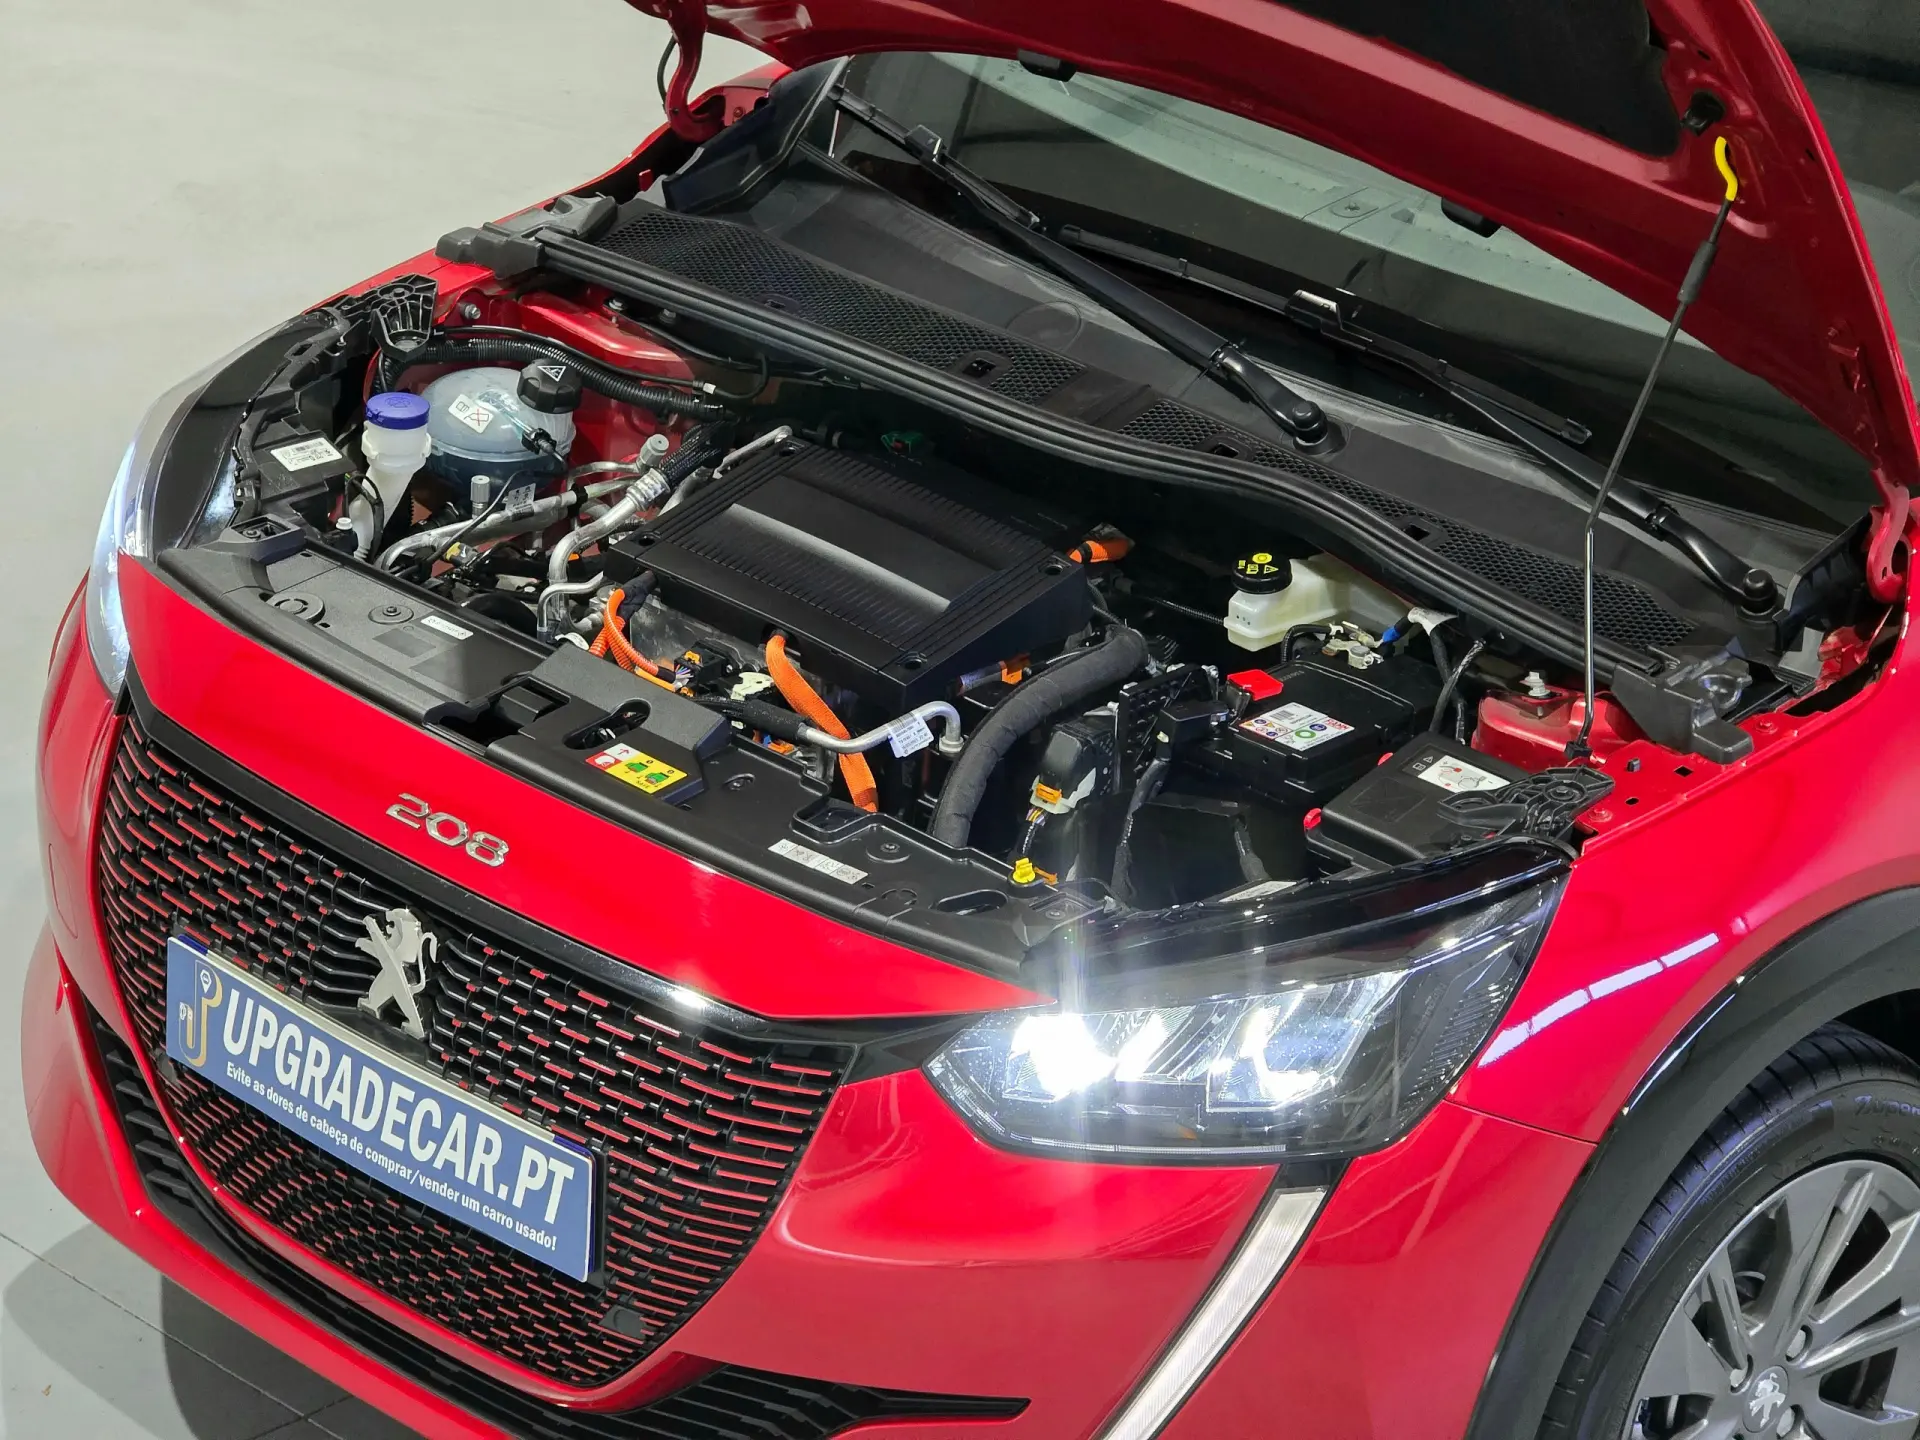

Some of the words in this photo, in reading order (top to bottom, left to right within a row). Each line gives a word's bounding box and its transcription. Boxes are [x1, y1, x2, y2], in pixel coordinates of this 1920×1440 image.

[385, 792, 510, 867] 208
[222, 988, 575, 1225] UPGRADECAR.PT
[226, 1061, 252, 1088] Evite
[252, 1078, 265, 1095] as
[266, 1086, 295, 1115] dores
[297, 1106, 309, 1124] de
[310, 1113, 349, 1148] cabeça
[349, 1134, 364, 1154] de
[365, 1147, 460, 1204] comprar/vender
[461, 1192, 481, 1214] um
[482, 1204, 514, 1229] carro
[515, 1223, 558, 1252] usado!
